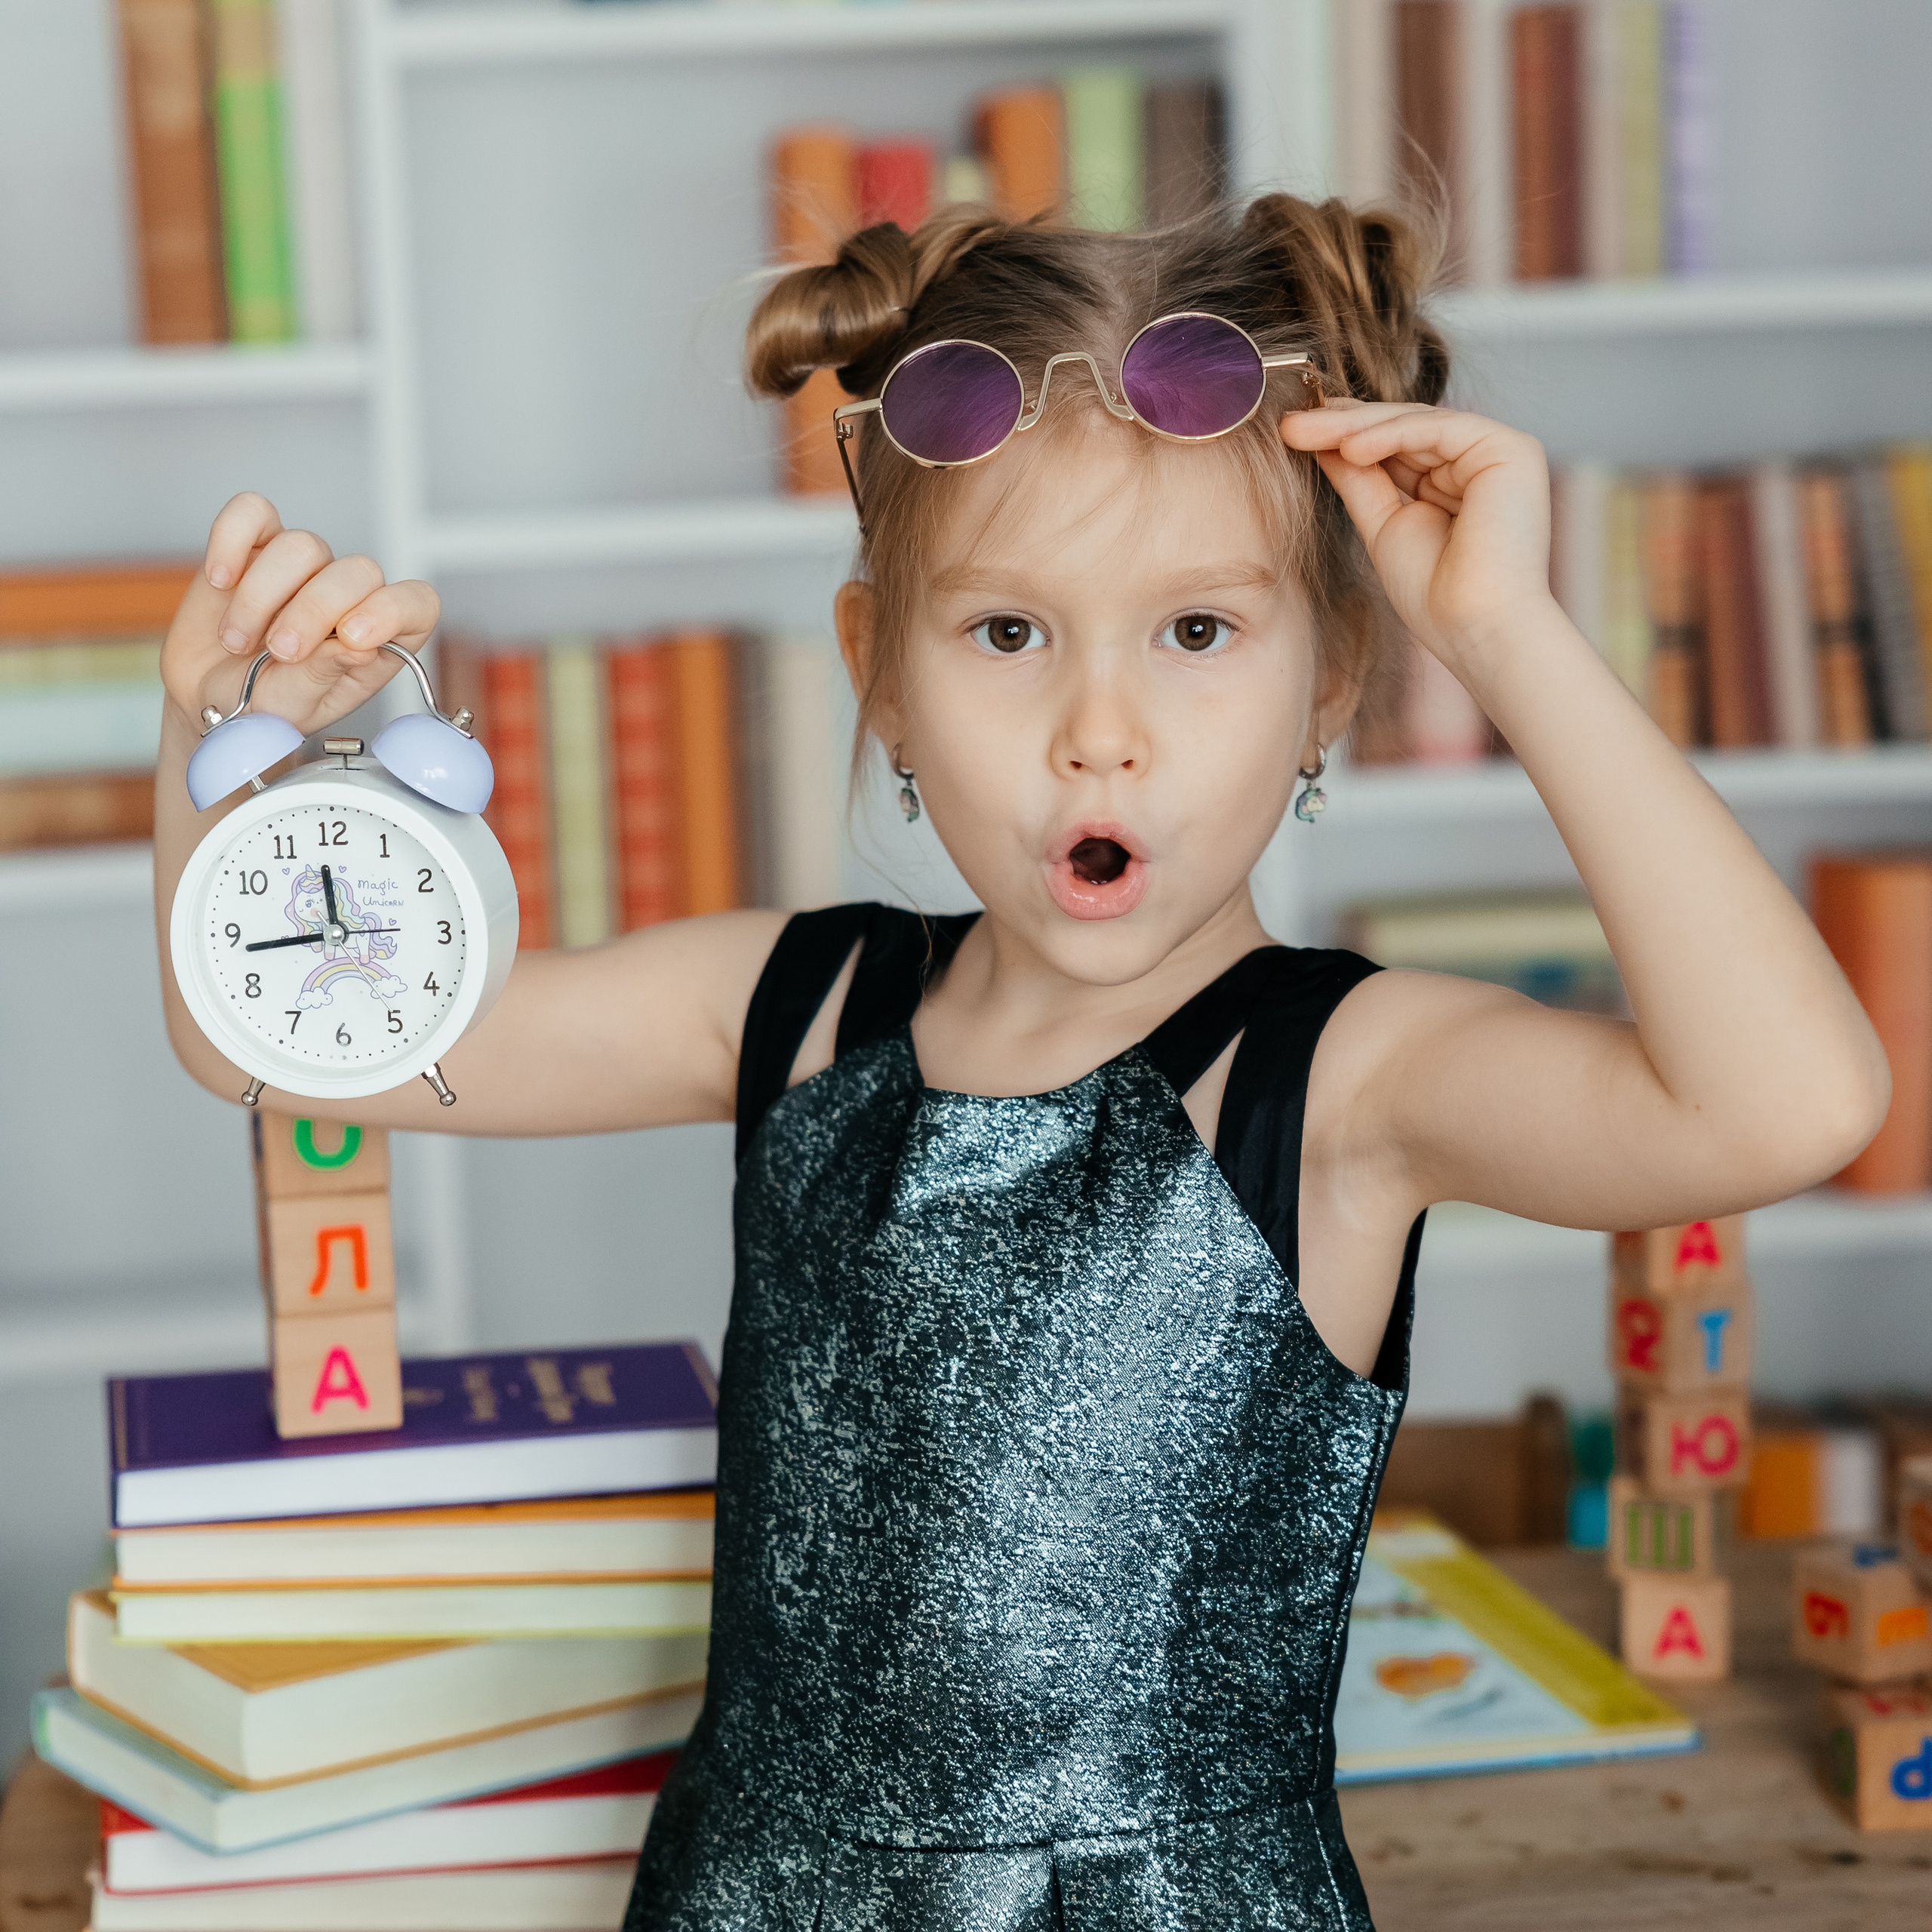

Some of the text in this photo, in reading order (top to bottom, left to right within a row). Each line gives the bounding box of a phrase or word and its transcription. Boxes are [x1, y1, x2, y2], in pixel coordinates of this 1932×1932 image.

[318, 821, 349, 846] 12
[380, 834, 390, 858] 1
[274, 835, 297, 859] 11
[239, 870, 268, 895] 10
[417, 869, 434, 893] 2
[225, 923, 241, 948] 9
[437, 921, 451, 945] 3
[245, 973, 261, 998] 8
[423, 971, 440, 996] 4
[285, 1011, 302, 1035] 7
[388, 1008, 403, 1033] 5
[336, 1023, 352, 1046] 6
[309, 1225, 369, 1297] Л
[1669, 1414, 1739, 1478] Ю
